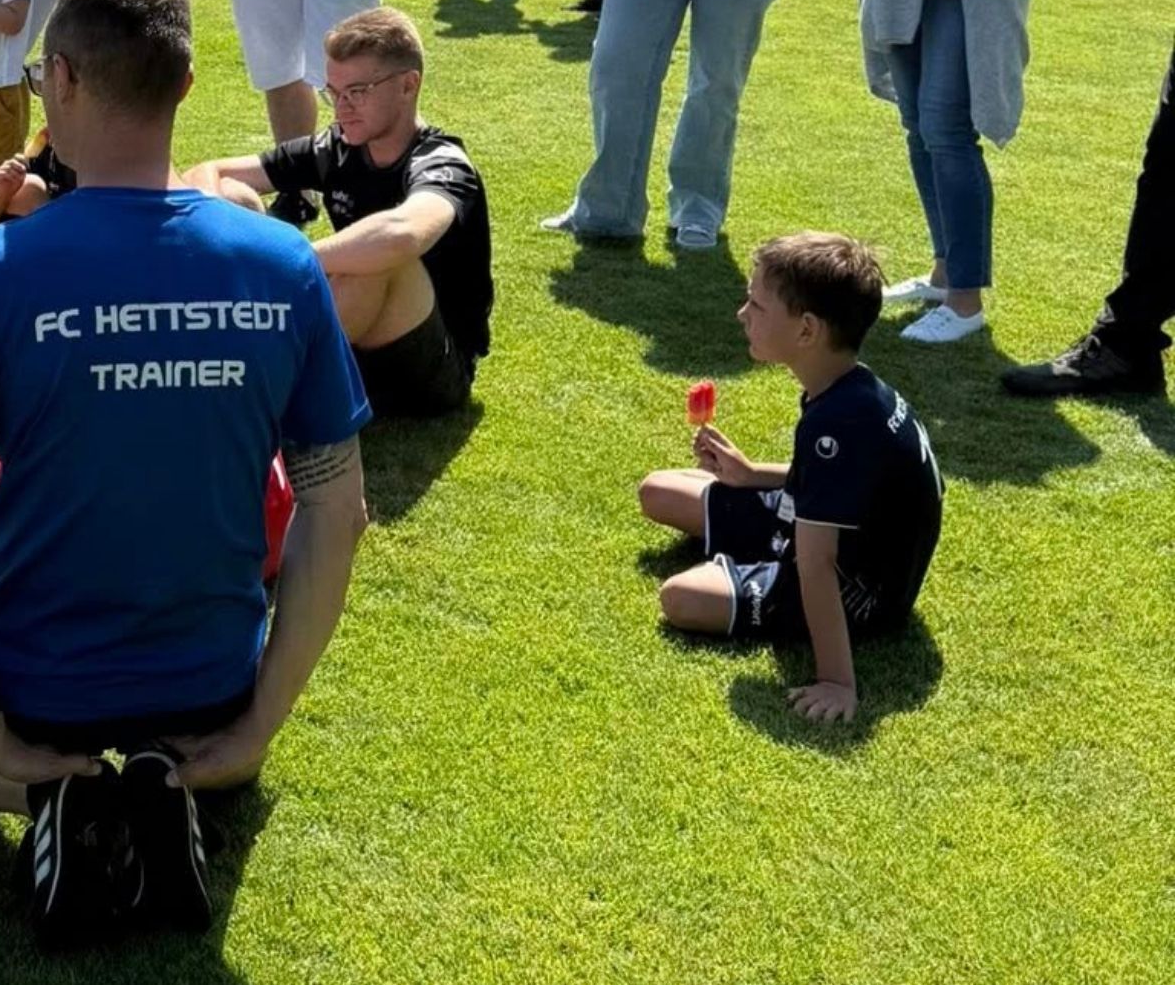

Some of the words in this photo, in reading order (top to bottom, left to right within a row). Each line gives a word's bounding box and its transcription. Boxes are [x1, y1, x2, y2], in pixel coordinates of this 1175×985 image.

[34, 308, 82, 343] FC
[94, 301, 292, 335] HETTSTEDT
[90, 360, 246, 391] TRAINER
